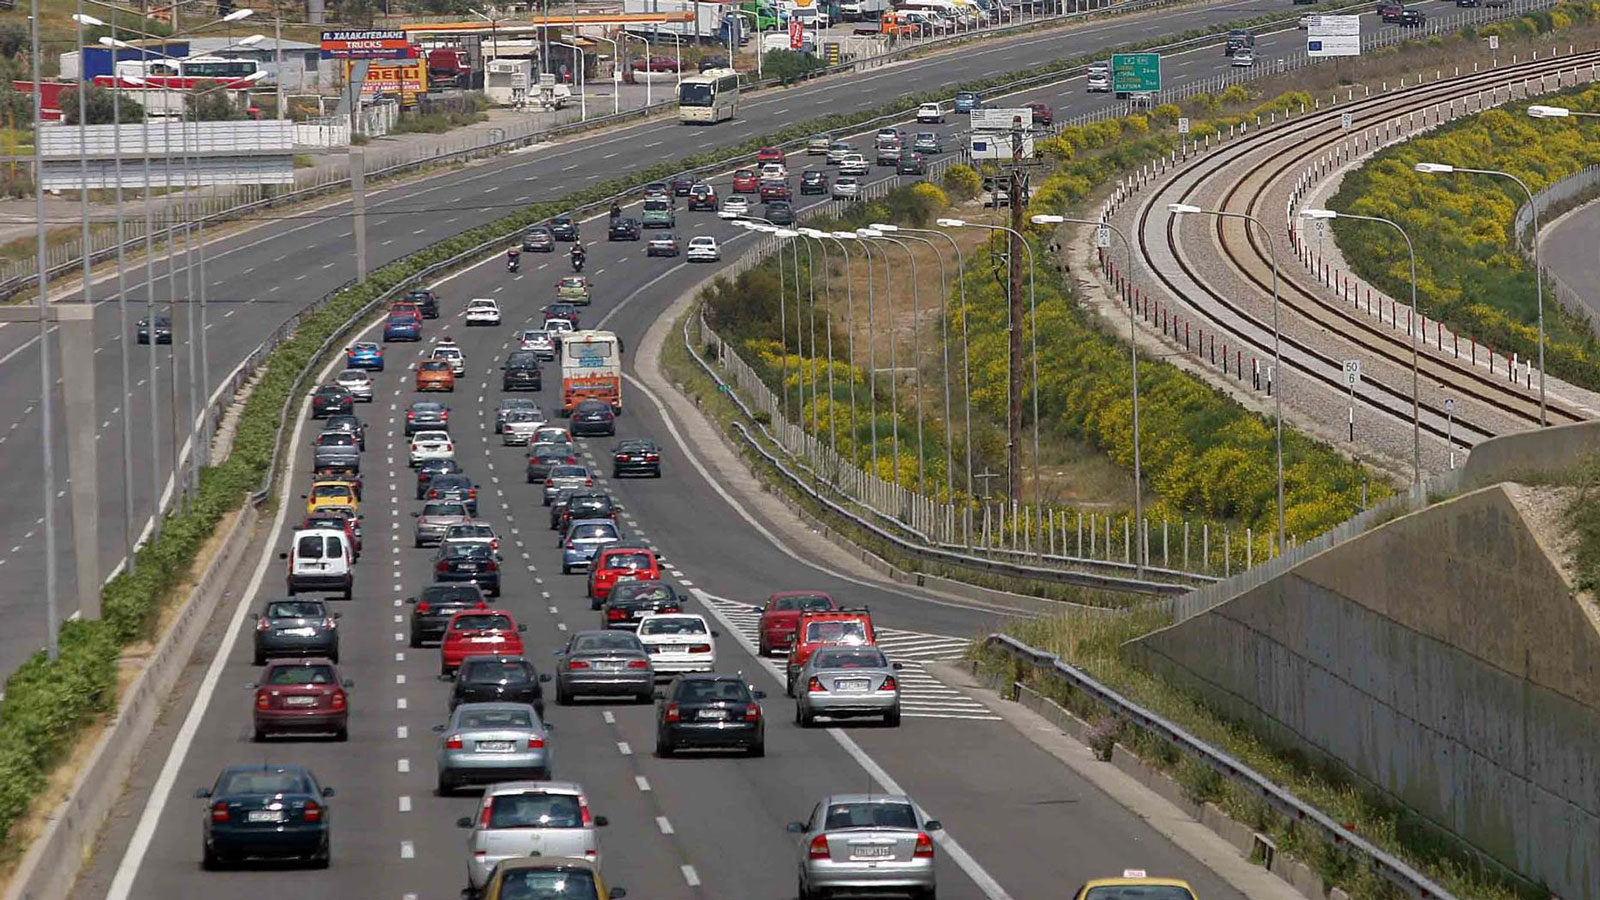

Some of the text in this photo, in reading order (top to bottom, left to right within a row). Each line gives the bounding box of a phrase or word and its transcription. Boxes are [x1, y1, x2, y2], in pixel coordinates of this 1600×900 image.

[367, 70, 419, 80] RELLI
[1346, 361, 1357, 371] 50
[1349, 373, 1354, 383] 6
